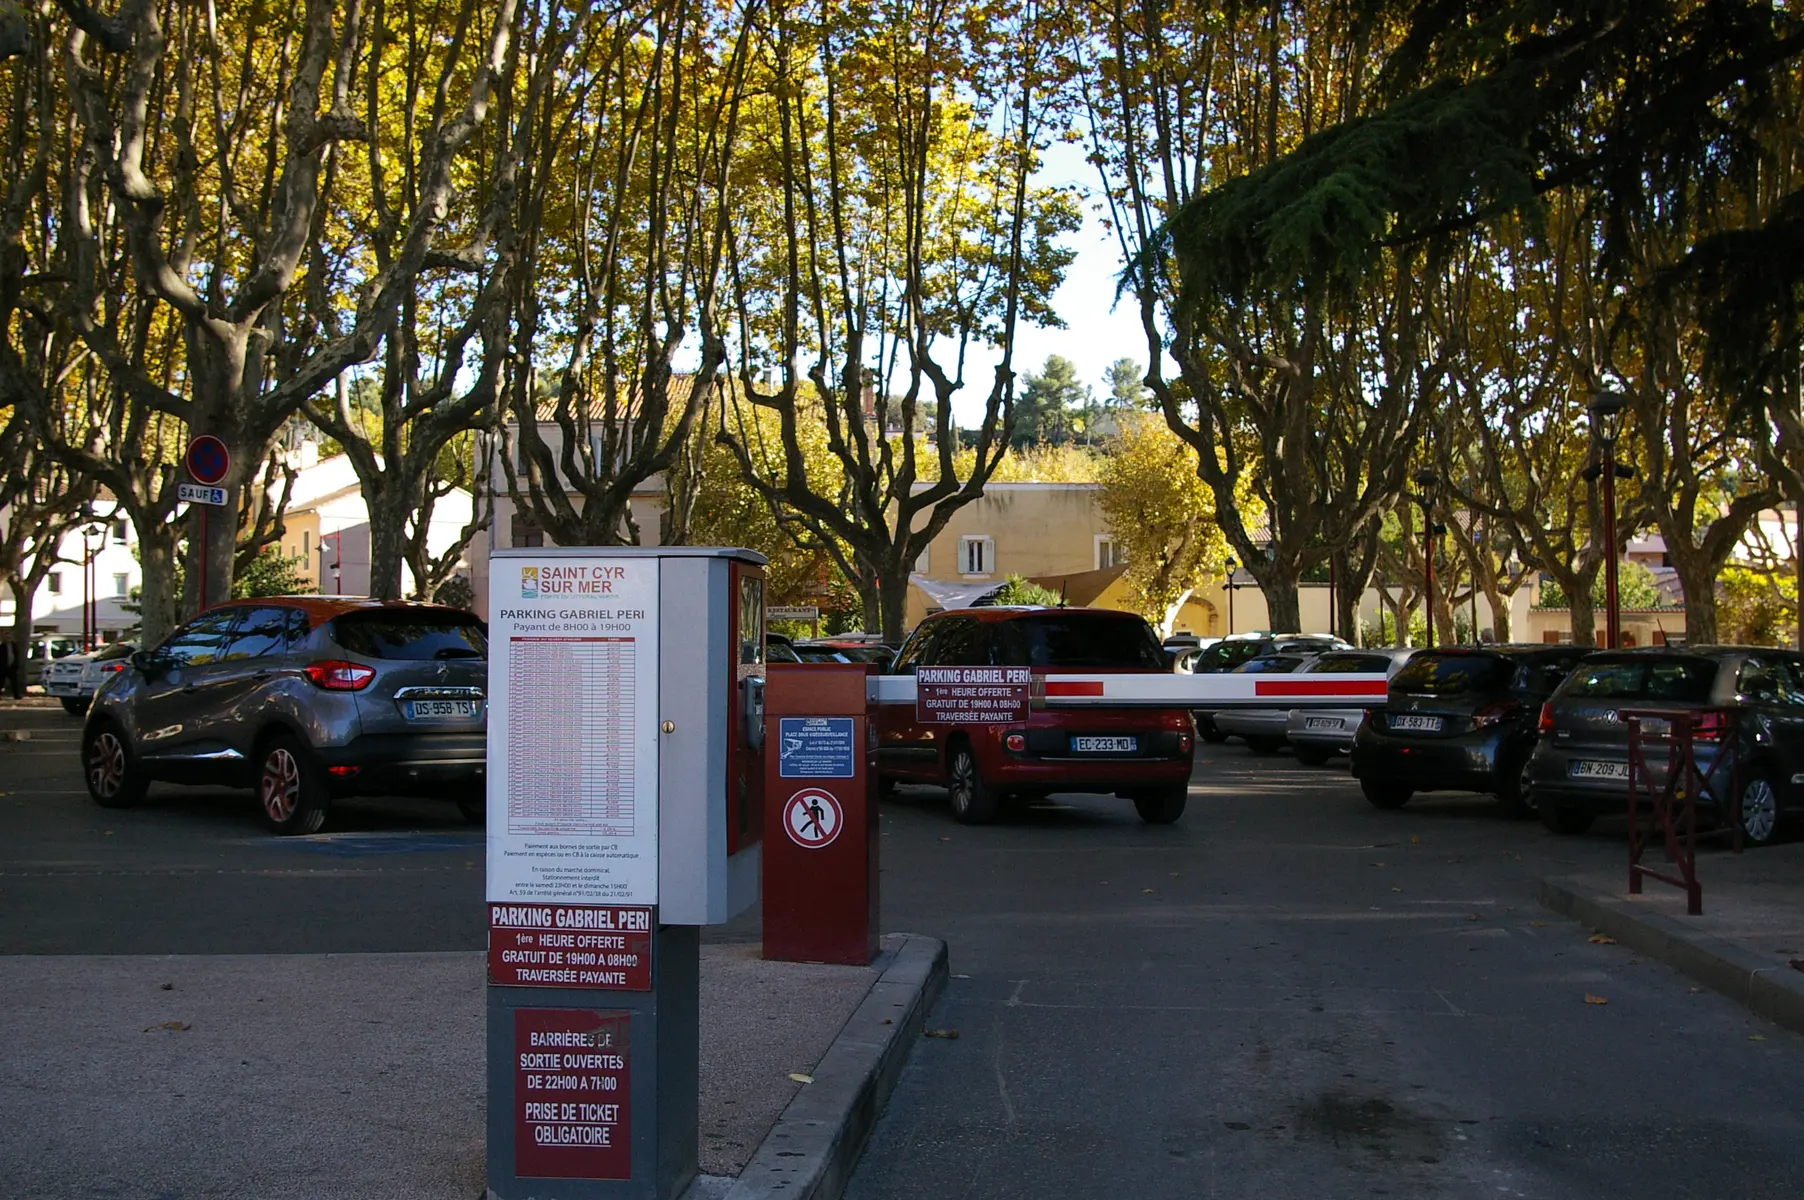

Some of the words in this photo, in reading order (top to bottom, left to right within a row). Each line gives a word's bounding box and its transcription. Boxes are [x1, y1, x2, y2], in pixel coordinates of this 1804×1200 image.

[180, 487, 209, 499] SAUF
[541, 567, 587, 579] SAINT
[592, 567, 625, 579] CYR
[541, 581, 573, 593] SUR
[578, 581, 612, 593] MER
[500, 610, 556, 619] PARKING
[560, 610, 613, 619] GABRIEL
[617, 610, 644, 619] PERI
[514, 623, 546, 633] Payant
[549, 623, 560, 631] de
[563, 623, 588, 631] 8H00
[591, 623, 597, 631] à
[919, 670, 961, 682] PARKING
[963, 670, 1004, 682] GABRIEL
[1007, 670, 1028, 682] PERI
[952, 688, 976, 696] HEURE
[978, 688, 1012, 696] OFFERTE
[926, 700, 957, 708] GRATUIT
[959, 700, 968, 708] DE
[970, 700, 991, 708] 19H00
[993, 700, 998, 708] A
[1000, 700, 1020, 708] 08H00
[936, 711, 978, 720] TRAVERSÉE
[980, 712, 1013, 720] PAYANTE
[492, 906, 551, 927] PARKING
[556, 909, 614, 929] GABRIEL
[619, 911, 649, 929] PERI
[516, 933, 533, 945] 1ère
[539, 934, 575, 948] HEURE
[577, 935, 625, 949] OFFERTE
[502, 950, 546, 963] GRATUIT
[549, 952, 563, 964] DE
[566, 953, 595, 965] 19H00
[598, 954, 605, 965] A
[607, 954, 638, 967] 08H00
[516, 968, 577, 983] TRAVERSÉE
[580, 971, 626, 984] PAYANTE
[531, 1029, 595, 1047] BARRIÈRES
[598, 1034, 612, 1047] DE
[520, 1053, 560, 1068] SORTIE
[563, 1054, 624, 1069] OUVERTES
[528, 1075, 542, 1088] DE
[545, 1076, 577, 1089] 22H00
[580, 1076, 588, 1089] A
[591, 1077, 617, 1090] 7H00
[525, 1103, 558, 1120] PRISE
[561, 1104, 576, 1120] DE
[579, 1104, 619, 1121] TICKET
[535, 1126, 610, 1144] OBLIGATOIRE
